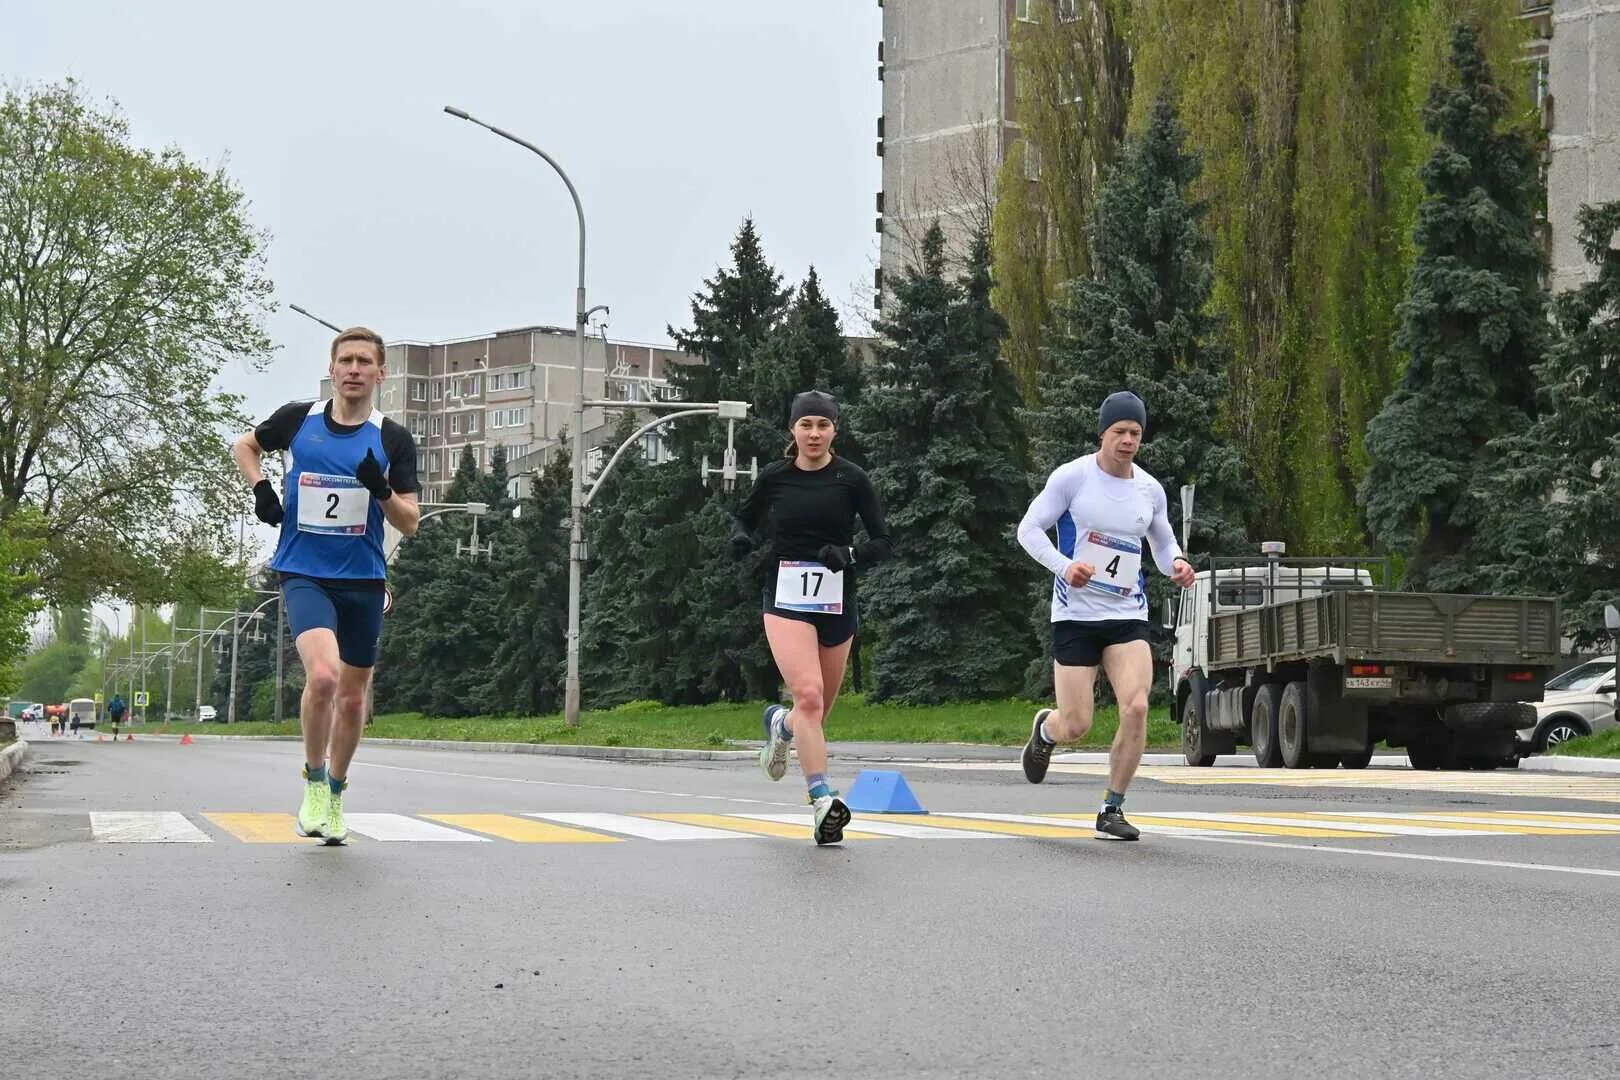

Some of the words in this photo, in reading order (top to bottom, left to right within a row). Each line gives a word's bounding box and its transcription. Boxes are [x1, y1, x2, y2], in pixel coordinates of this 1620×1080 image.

[325, 493, 340, 519] 2
[1105, 555, 1121, 578] 4
[800, 571, 824, 597] 17
